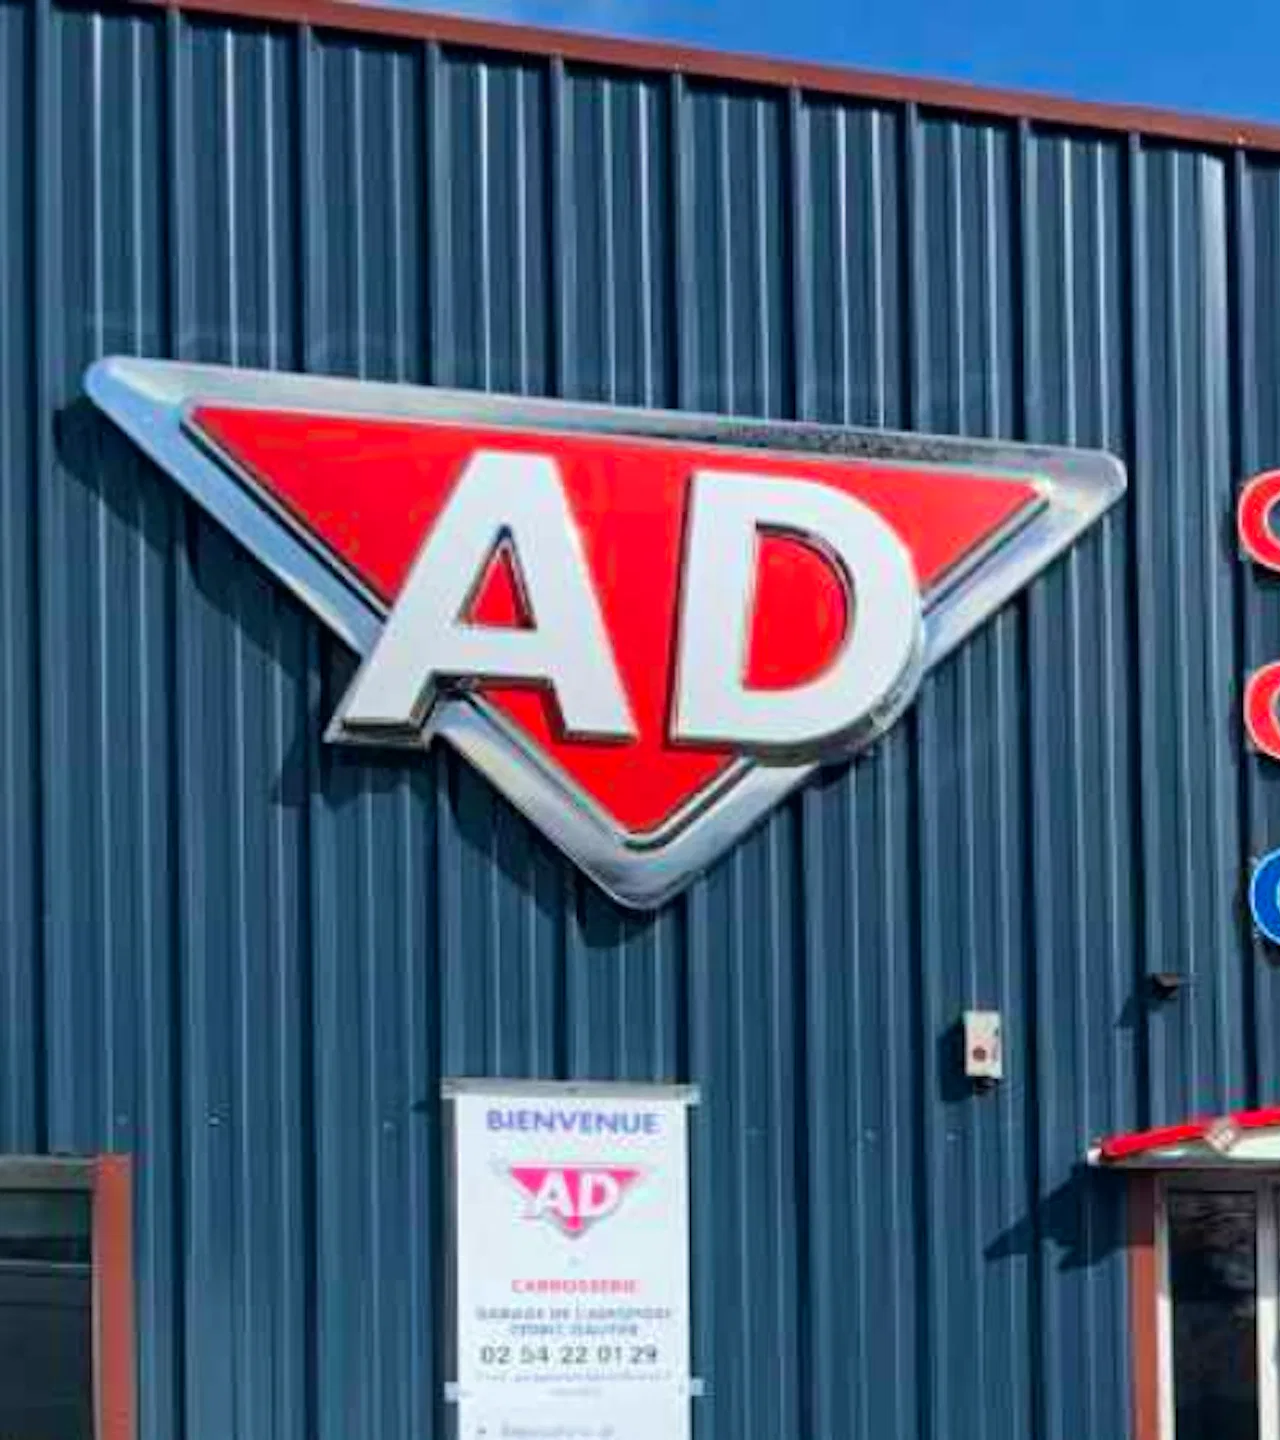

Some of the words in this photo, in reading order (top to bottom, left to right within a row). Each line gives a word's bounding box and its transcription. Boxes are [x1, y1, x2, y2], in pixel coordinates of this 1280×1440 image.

[322, 449, 928, 764] AD
[486, 1108, 658, 1135] BIENVENUE
[481, 1346, 510, 1364] 02
[519, 1346, 549, 1364] 54
[560, 1346, 588, 1364] 22
[597, 1346, 623, 1364] 01
